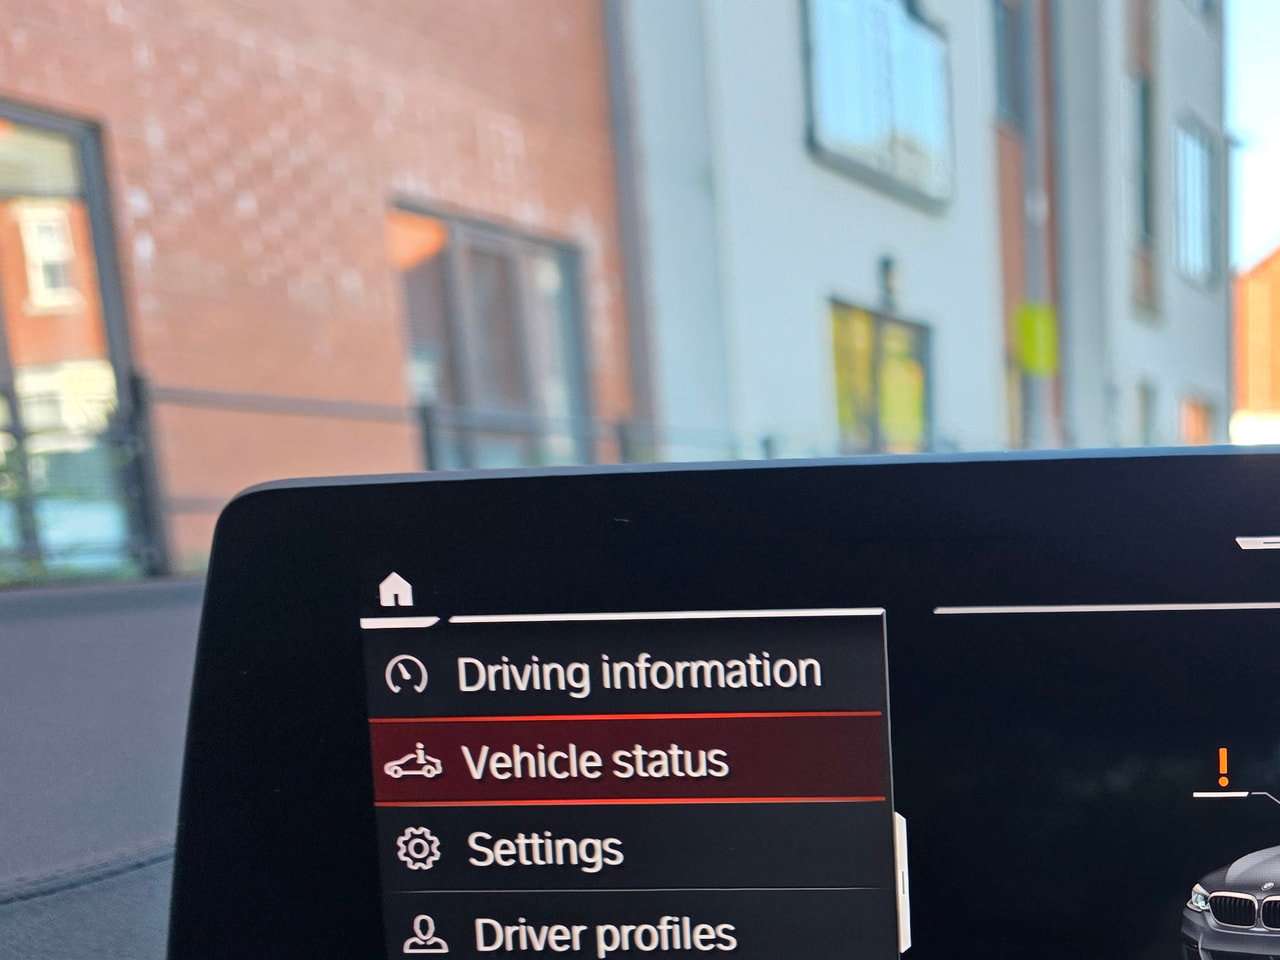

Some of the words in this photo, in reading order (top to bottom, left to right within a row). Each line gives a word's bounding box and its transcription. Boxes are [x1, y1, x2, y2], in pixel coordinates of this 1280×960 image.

[457, 655, 591, 699] Driving
[601, 651, 822, 690] information
[460, 743, 602, 780] Vehicle
[612, 743, 729, 779] status
[468, 830, 625, 873] Settings
[475, 917, 588, 952] Driver
[596, 915, 738, 959] profiles
